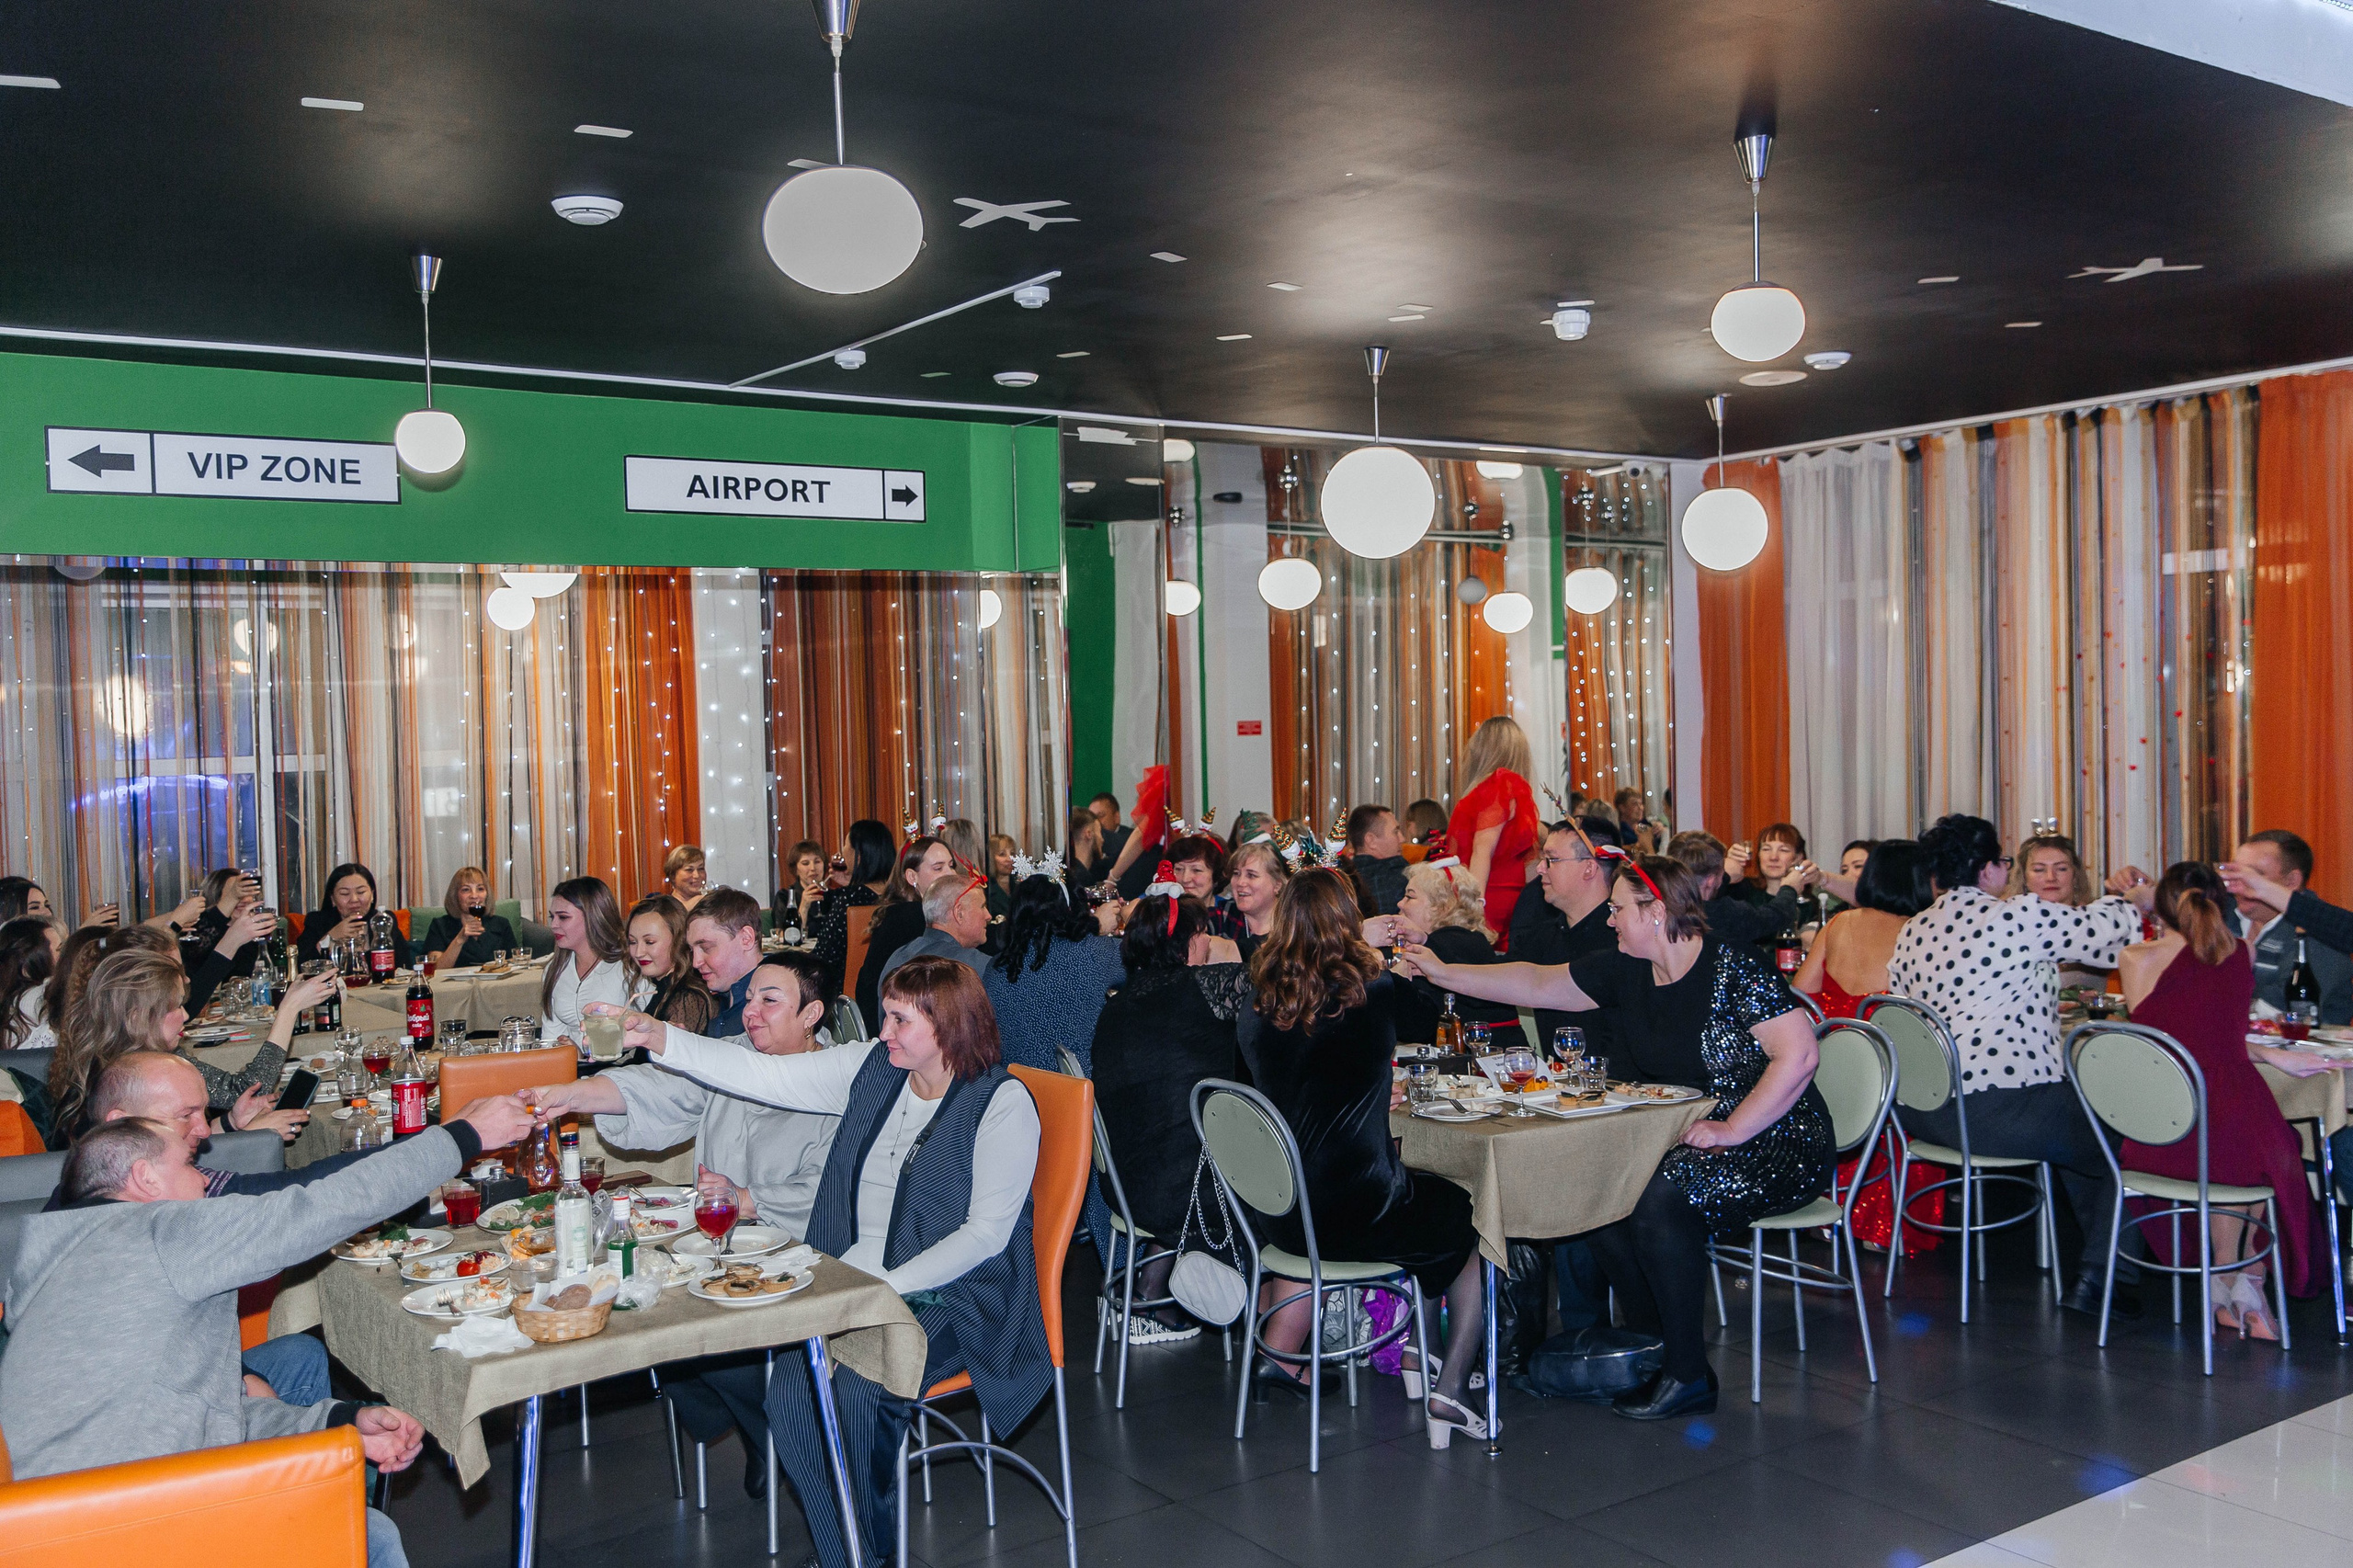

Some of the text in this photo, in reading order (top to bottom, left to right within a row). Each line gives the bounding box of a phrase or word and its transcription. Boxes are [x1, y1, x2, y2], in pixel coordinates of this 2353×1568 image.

[188, 451, 361, 484] VIP ZONE
[686, 474, 831, 503] AIRPORT
